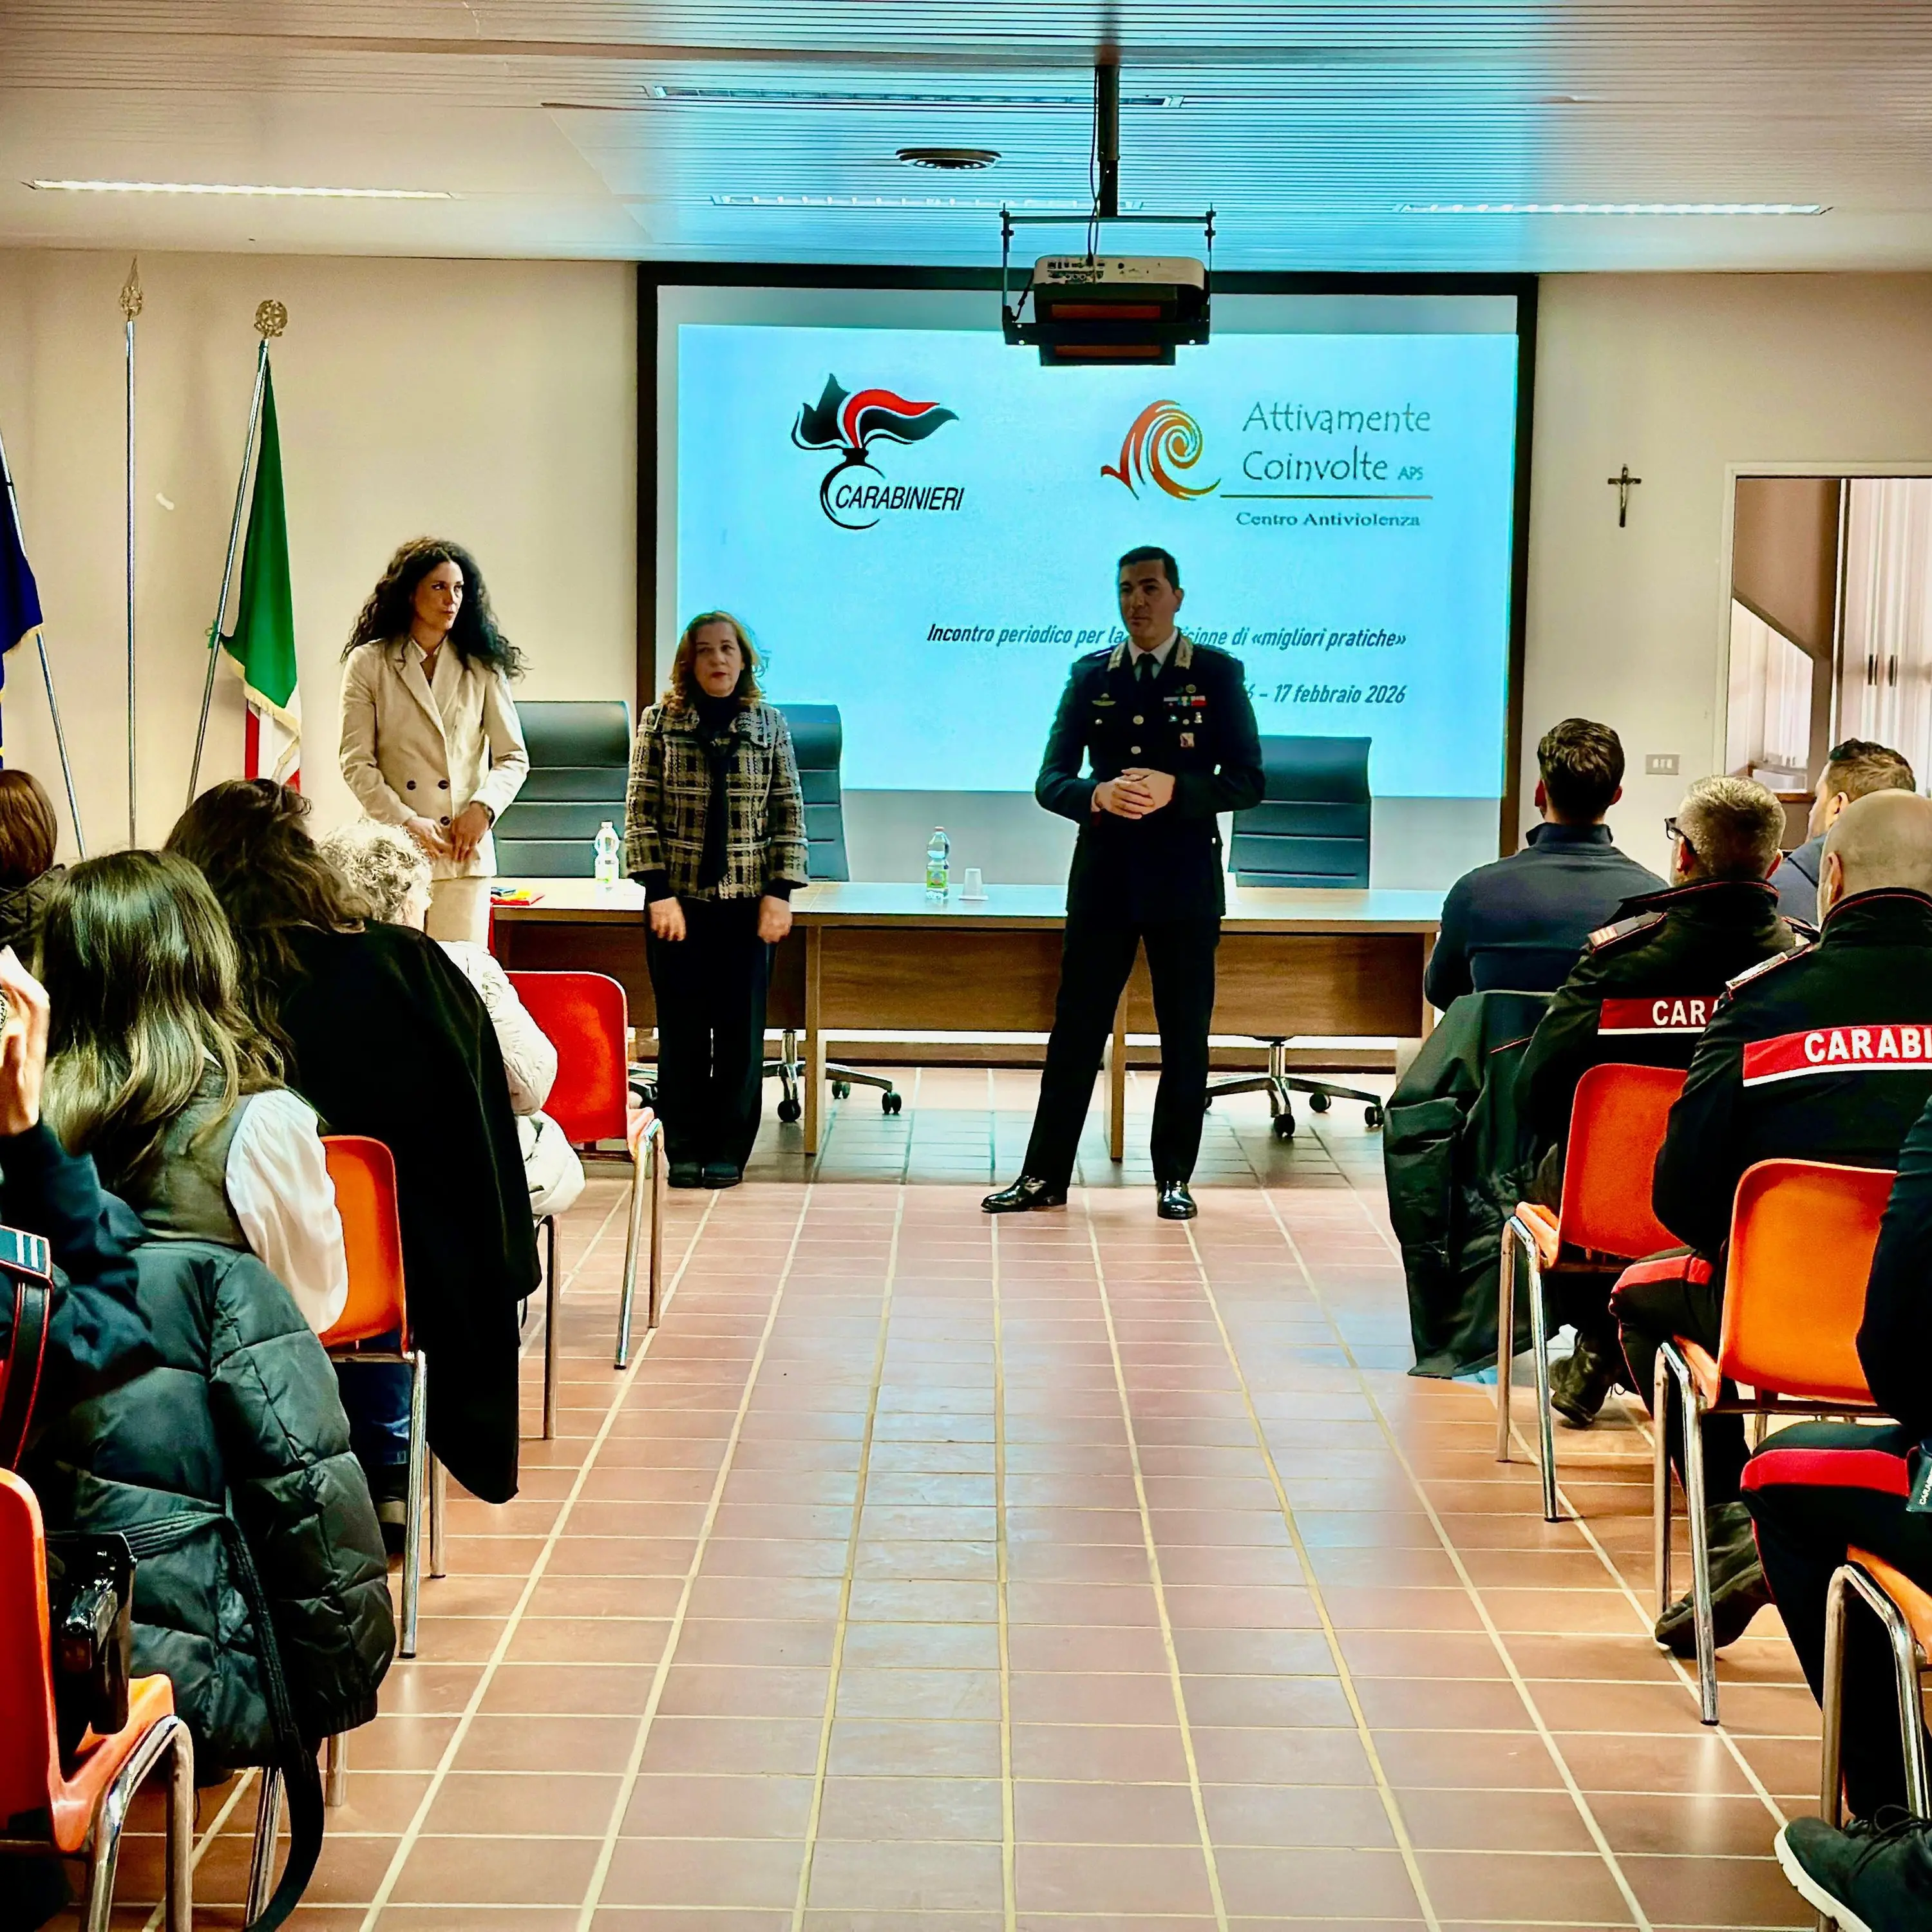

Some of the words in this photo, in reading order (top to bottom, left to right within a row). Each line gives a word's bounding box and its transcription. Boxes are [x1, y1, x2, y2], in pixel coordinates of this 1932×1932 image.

[1242, 401, 1431, 433] Attivamente
[1242, 445, 1388, 481] Coinvolte
[1397, 466, 1424, 480] APS
[835, 484, 965, 510] CARABINIERI
[1236, 512, 1298, 526] Centro
[1303, 512, 1421, 526] Antiviolenza
[927, 623, 994, 642] Incontro
[996, 625, 1072, 647] periodico
[1074, 628, 1105, 648] per
[1108, 627, 1126, 643] la
[1231, 627, 1250, 645] di
[1251, 627, 1327, 650] «migliori
[1325, 629, 1406, 650] pratiche»
[1274, 684, 1293, 702] 17
[1293, 685, 1361, 703] febbraio
[1364, 685, 1407, 703] 2026
